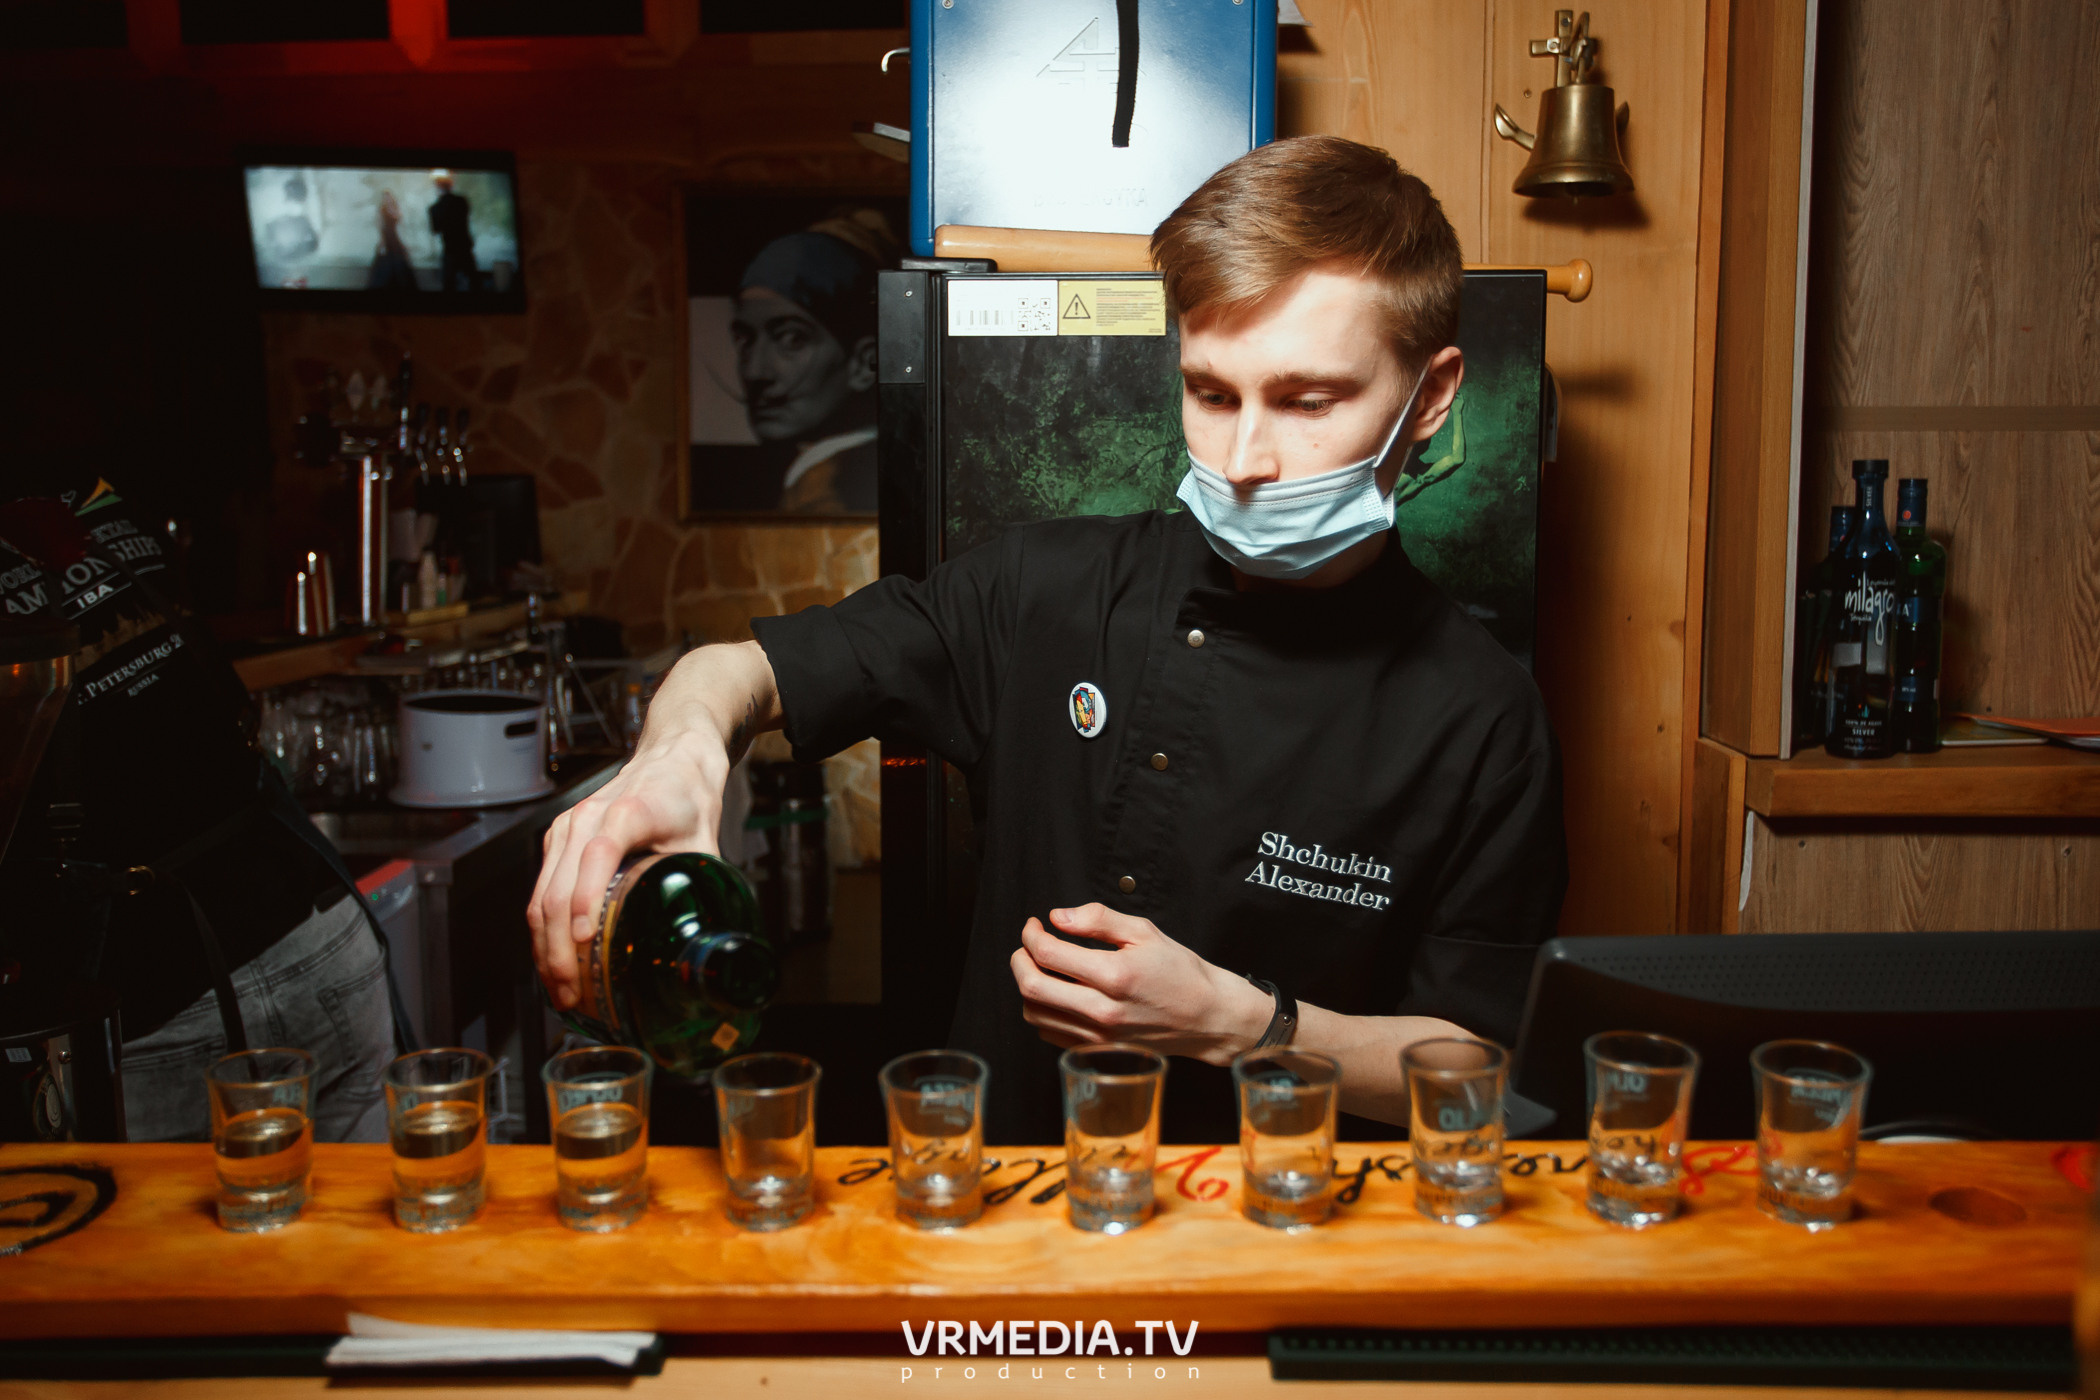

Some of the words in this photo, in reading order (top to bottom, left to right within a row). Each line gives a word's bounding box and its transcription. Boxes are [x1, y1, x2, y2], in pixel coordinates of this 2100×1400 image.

[75, 583, 114, 609] IBA
[1844, 570, 1895, 647] milagro
[1852, 728, 1875, 736] SILVER
[1257, 831, 1392, 883] Shchukin
[1244, 860, 1391, 911] Alexander
